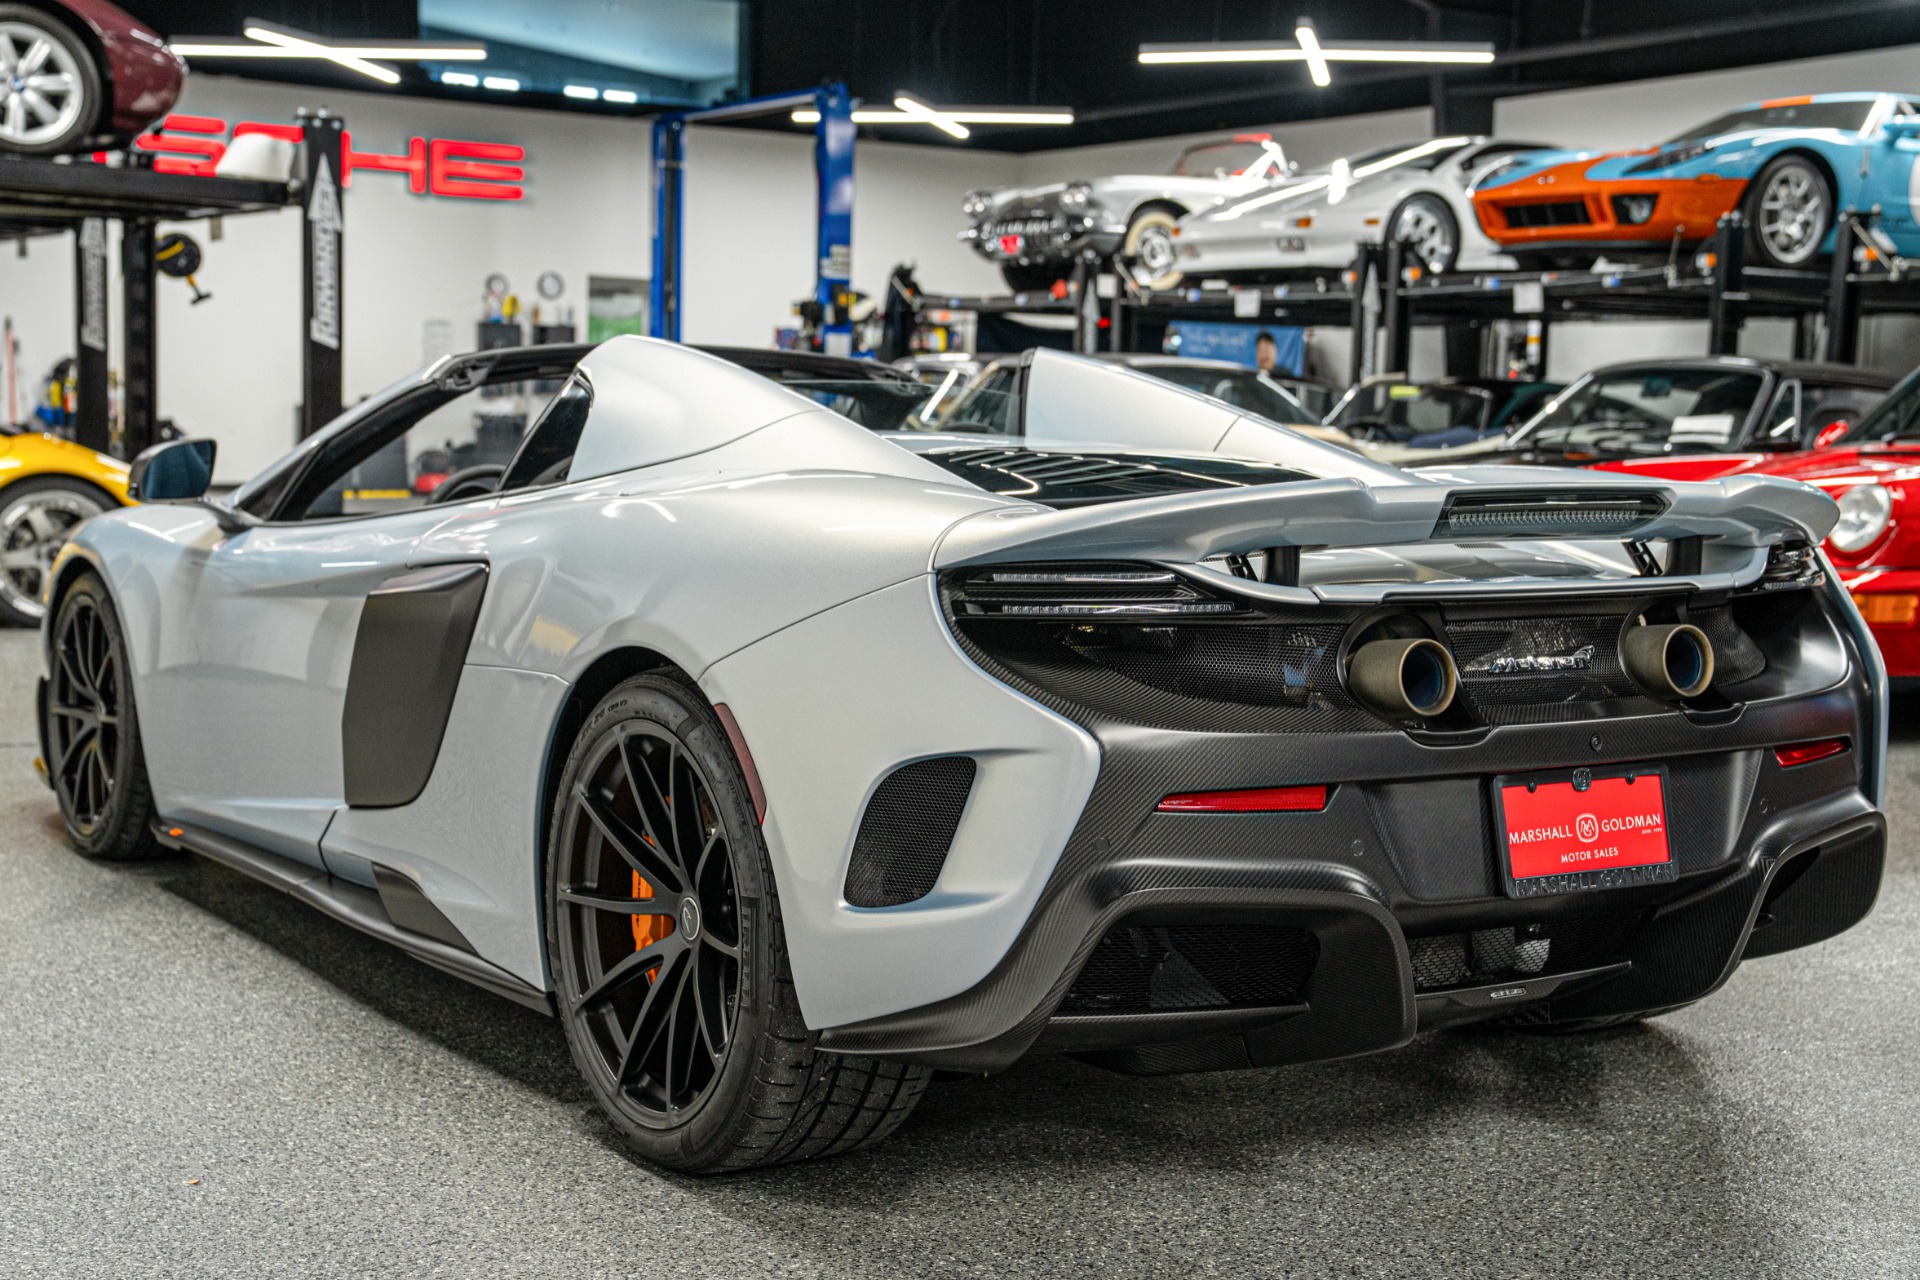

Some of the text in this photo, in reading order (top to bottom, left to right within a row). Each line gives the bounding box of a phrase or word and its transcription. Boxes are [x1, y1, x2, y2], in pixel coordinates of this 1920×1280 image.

[1509, 825, 1573, 845] MARSHALL
[1601, 813, 1661, 832] GOLDMAN
[1561, 847, 1619, 863] MOTOR SALES
[1515, 863, 1677, 897] MARSHALL GOLDMAN
